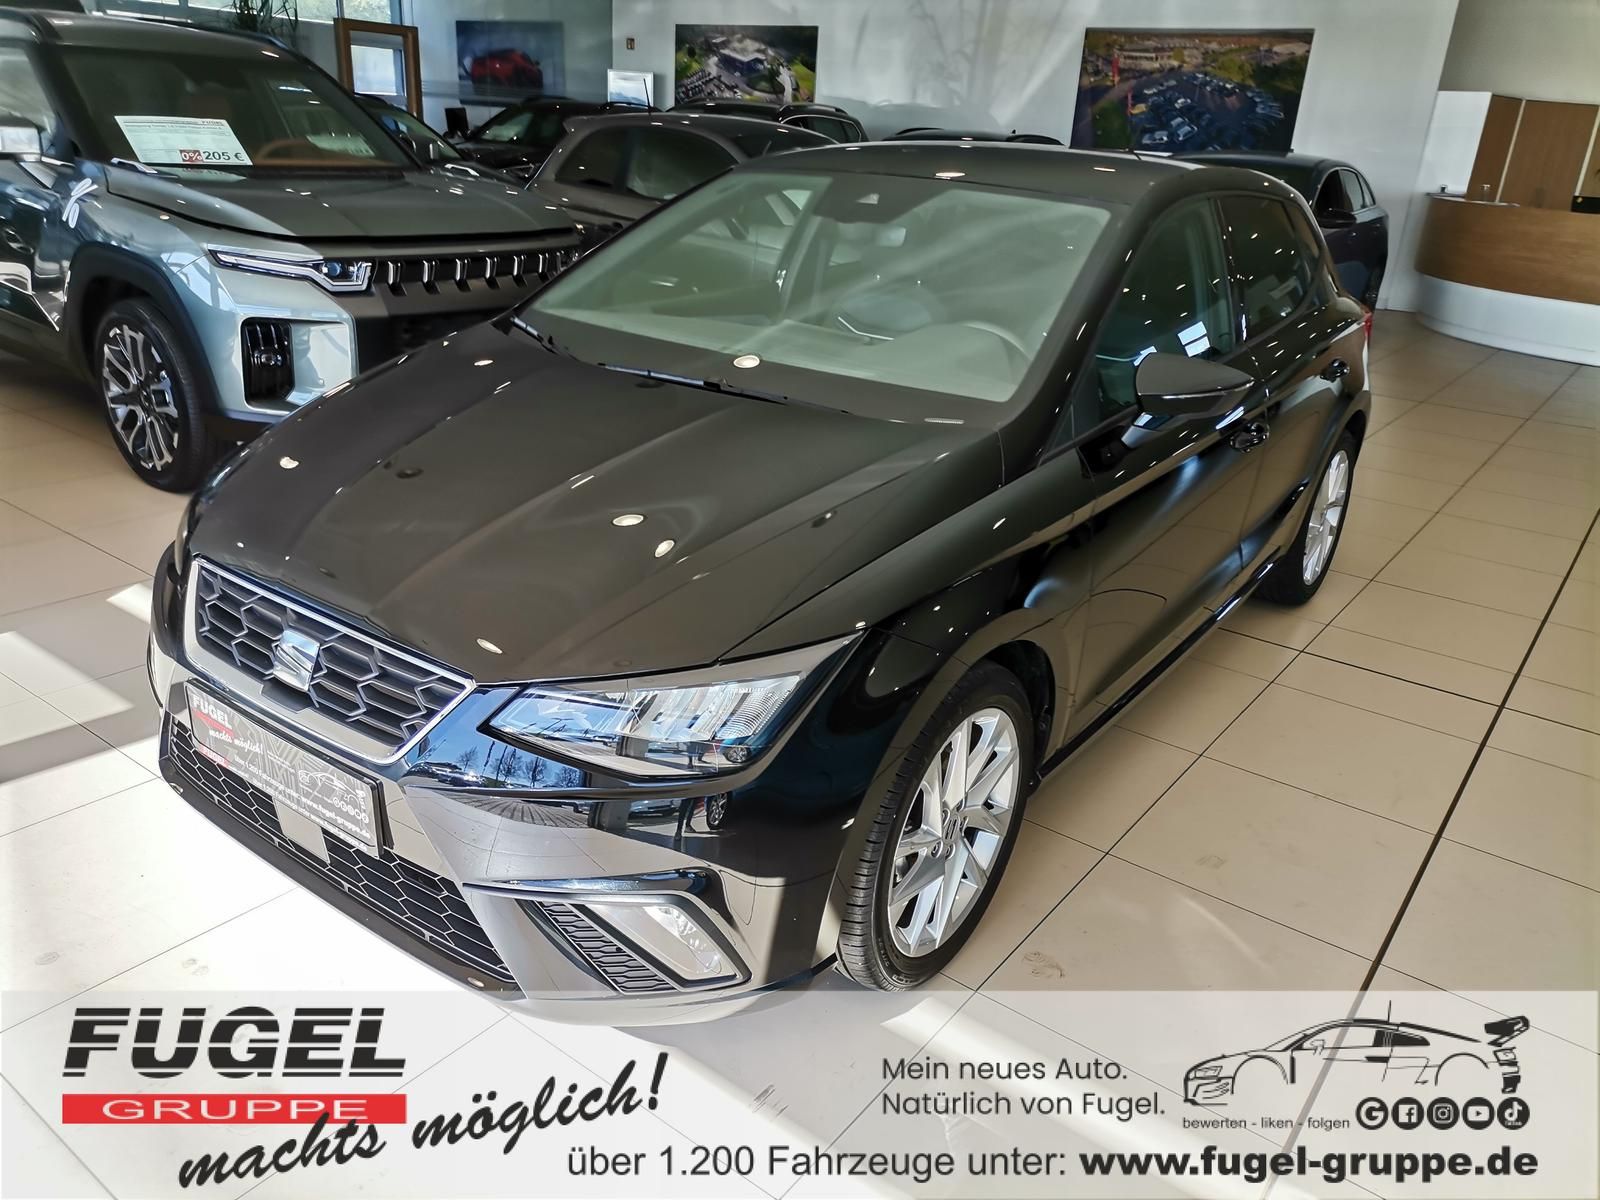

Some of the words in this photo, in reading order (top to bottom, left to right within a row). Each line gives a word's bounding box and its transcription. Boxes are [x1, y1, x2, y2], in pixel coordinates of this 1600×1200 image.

[181, 151, 202, 161] 0%
[203, 151, 231, 161] 205
[234, 152, 245, 162] €
[192, 694, 232, 730] FUGEL
